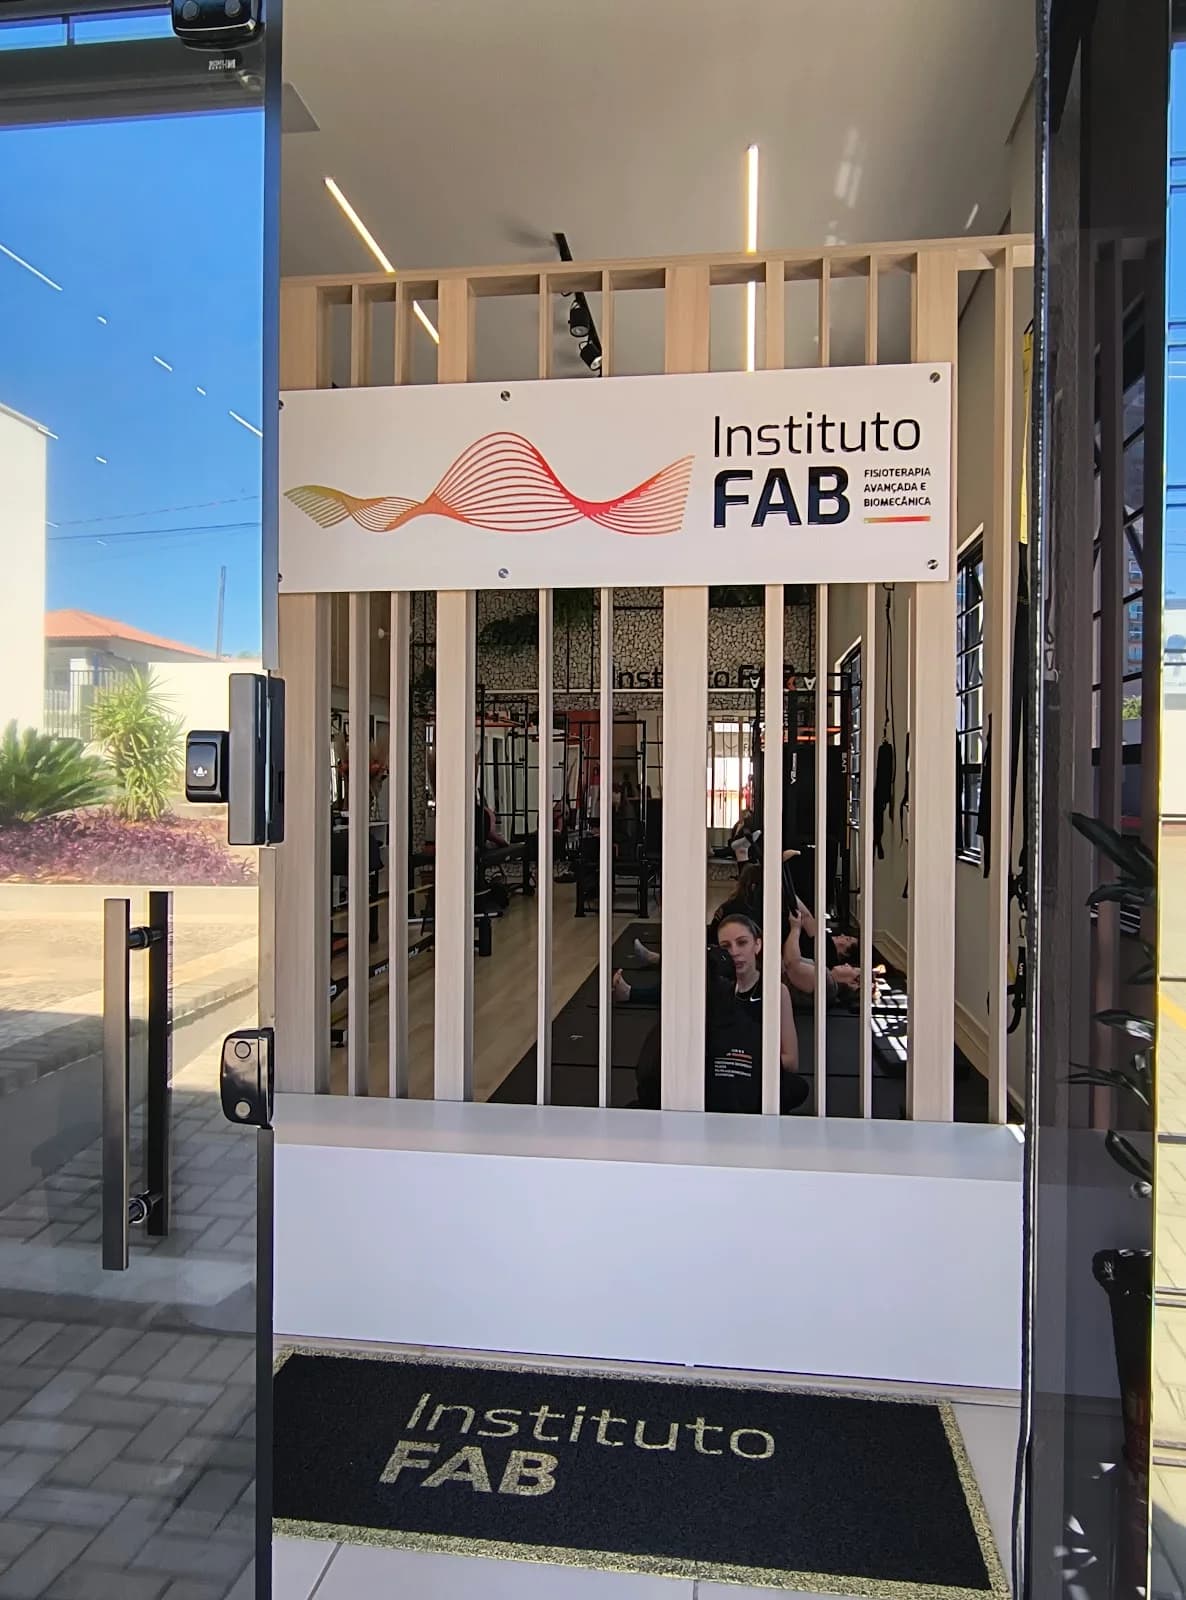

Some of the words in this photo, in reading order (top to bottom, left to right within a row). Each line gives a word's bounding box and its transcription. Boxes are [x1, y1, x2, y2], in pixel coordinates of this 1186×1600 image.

[714, 411, 920, 457] Instituto
[863, 467, 931, 478] FISIOTERAPIA
[863, 482, 918, 493] AVANÇADA
[920, 481, 926, 491] E
[713, 465, 850, 528] FAB
[863, 496, 931, 507] BIOMECÂNICA
[612, 664, 730, 689] Insto
[405, 1392, 776, 1460] Instituto
[378, 1439, 560, 1497] FAB
